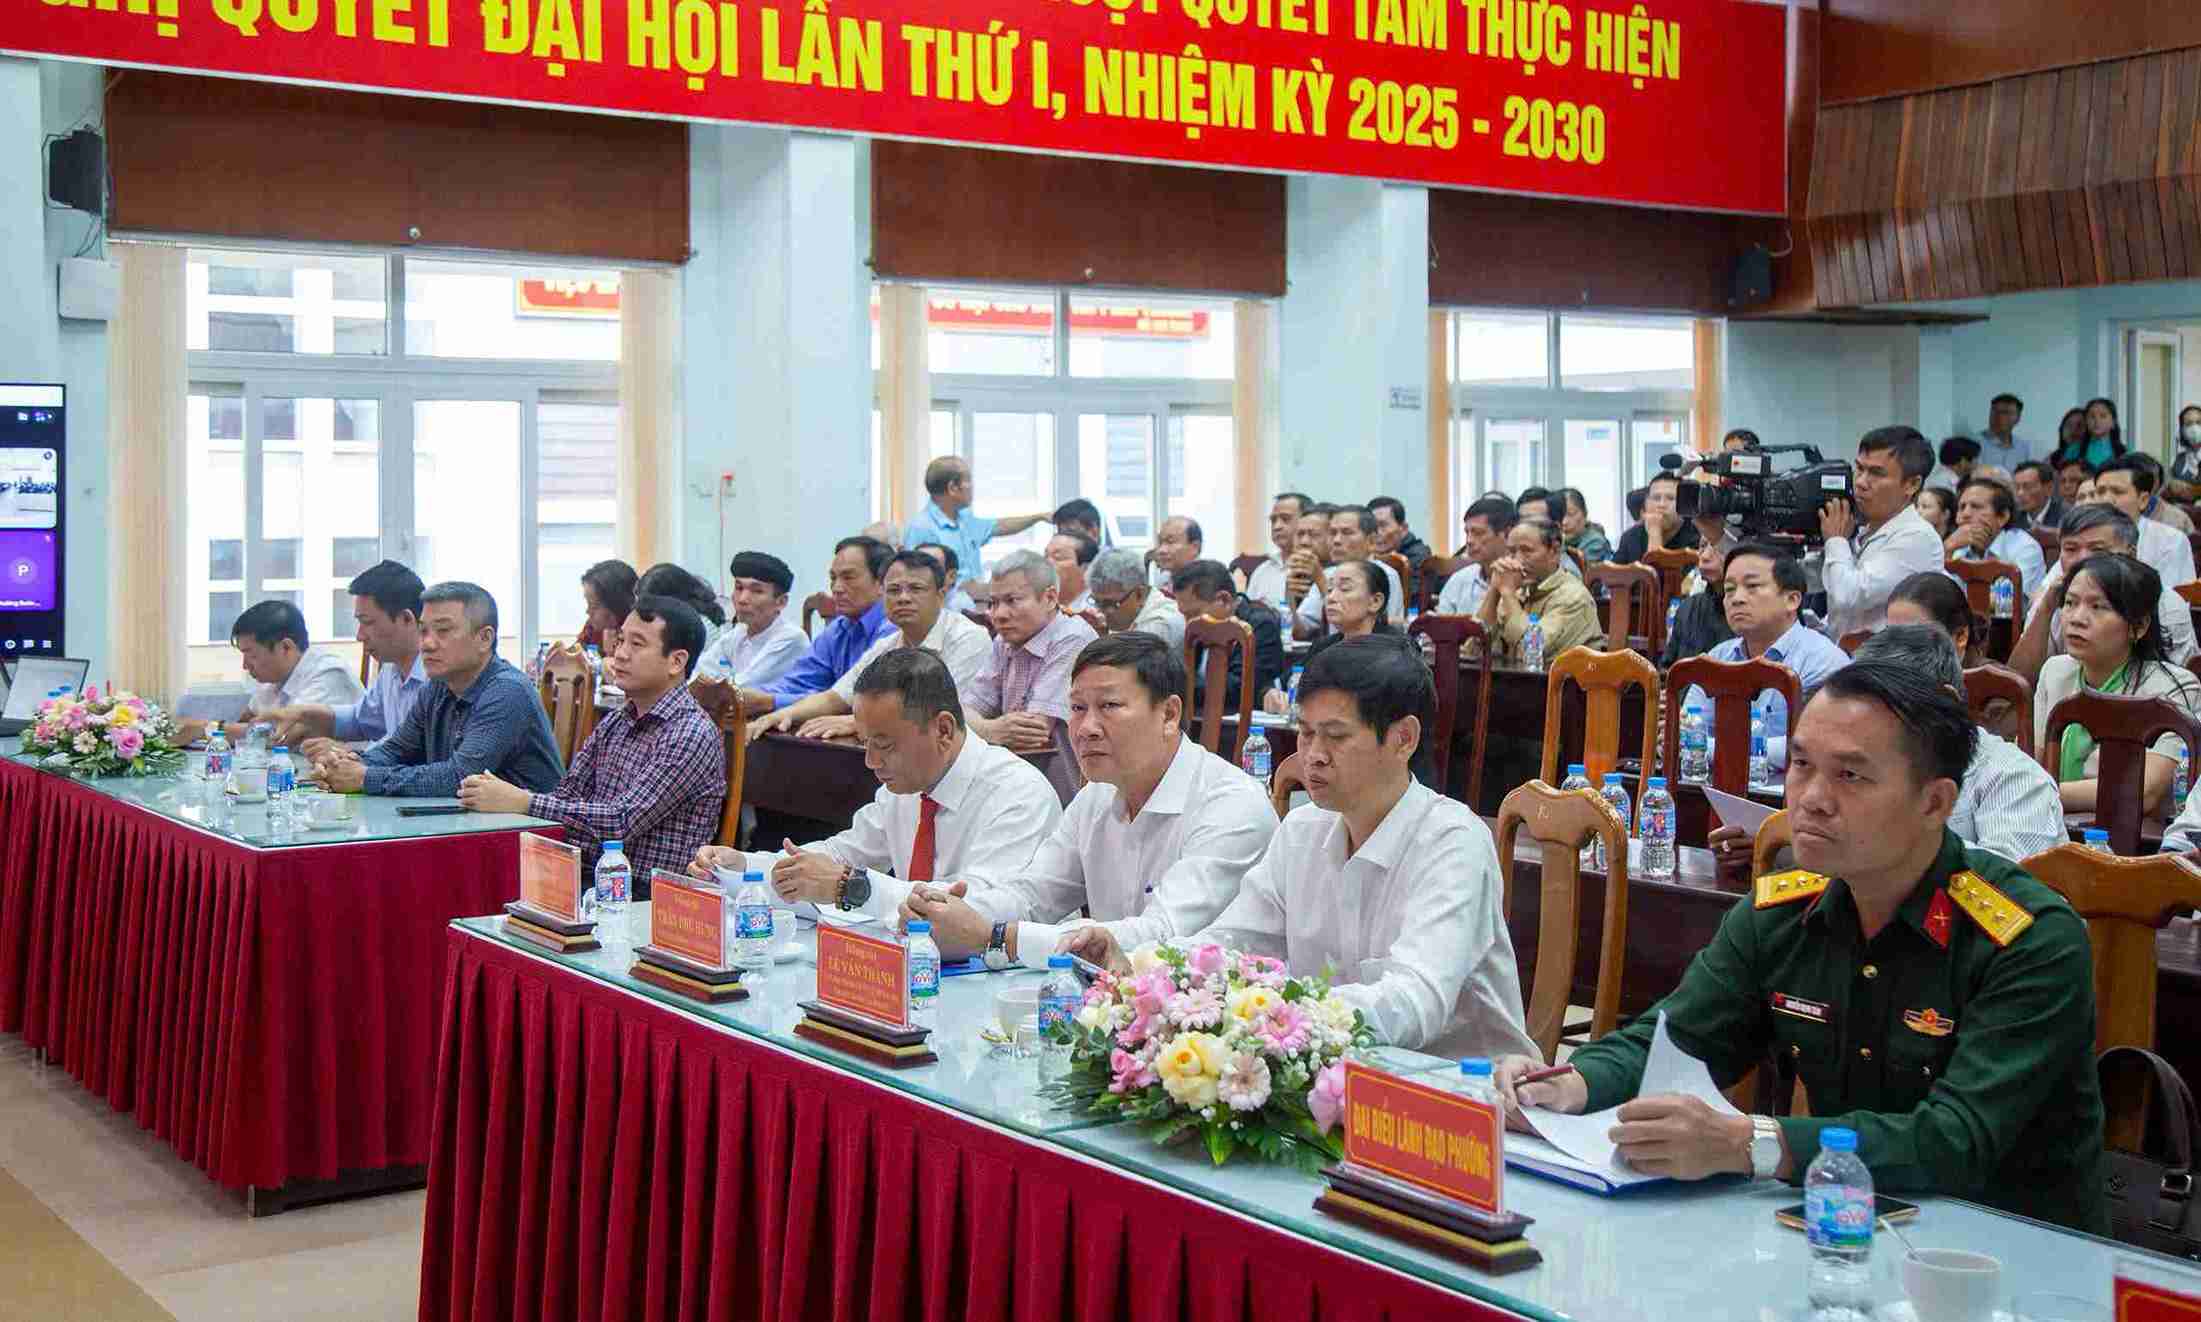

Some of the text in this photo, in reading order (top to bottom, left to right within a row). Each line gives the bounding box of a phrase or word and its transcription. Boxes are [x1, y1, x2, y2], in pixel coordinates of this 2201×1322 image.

[481, 0, 602, 77] ĐẠI
[902, 20, 1019, 105] THỨ
[1032, 39, 1066, 120] I,
[1084, 43, 1256, 139] NHIỆM
[1271, 57, 1334, 137] KỲ
[1347, 76, 1460, 150] 2025
[1472, 118, 1490, 134] -
[1503, 95, 1606, 165] 2030
[1462, 0, 1571, 76] THỰC
[1585, 3, 1680, 90] HIỆN
